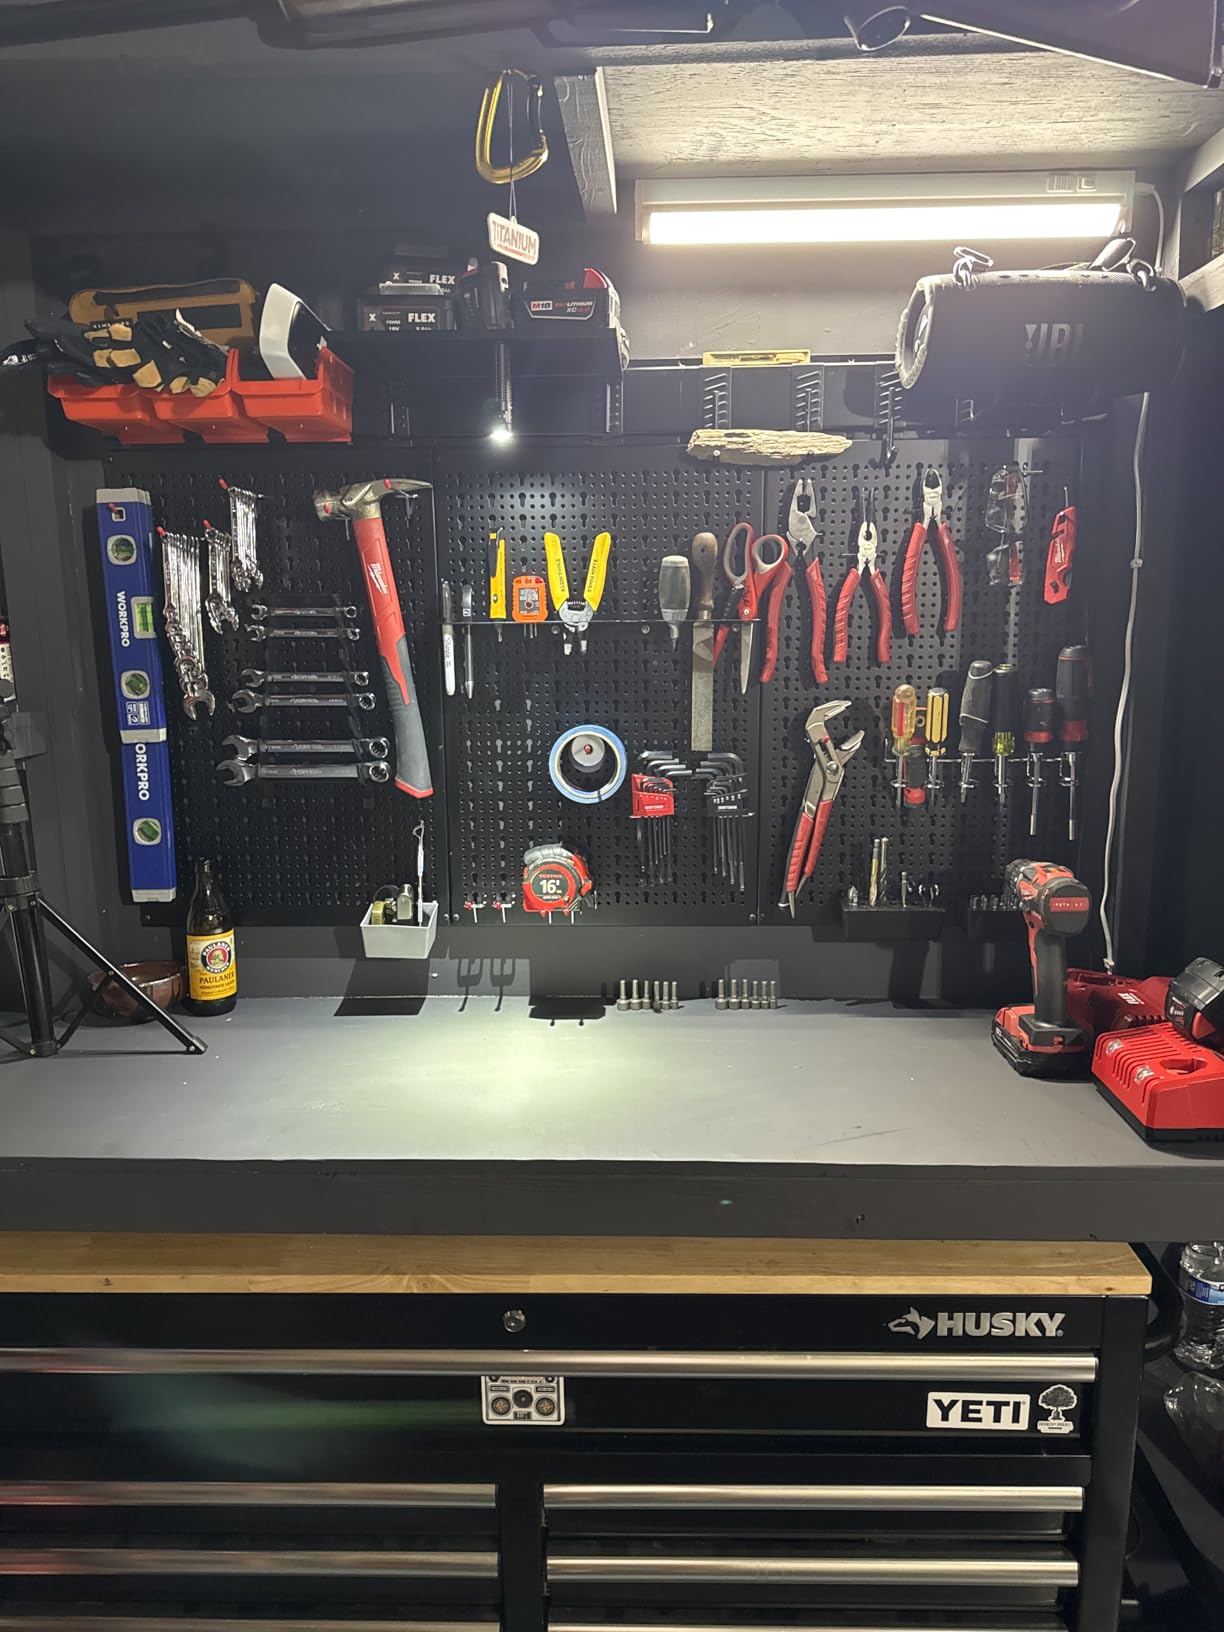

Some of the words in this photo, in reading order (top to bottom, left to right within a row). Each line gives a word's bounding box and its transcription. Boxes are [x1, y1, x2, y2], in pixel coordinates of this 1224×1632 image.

[429, 274, 456, 285] FLEX
[407, 312, 436, 323] FLEX
[532, 302, 551, 310] M18
[116, 590, 131, 647] WORKPRO
[135, 743, 150, 801] ORKPRO
[936, 1312, 1066, 1337] HUSKY
[933, 1398, 1021, 1424] YETI
